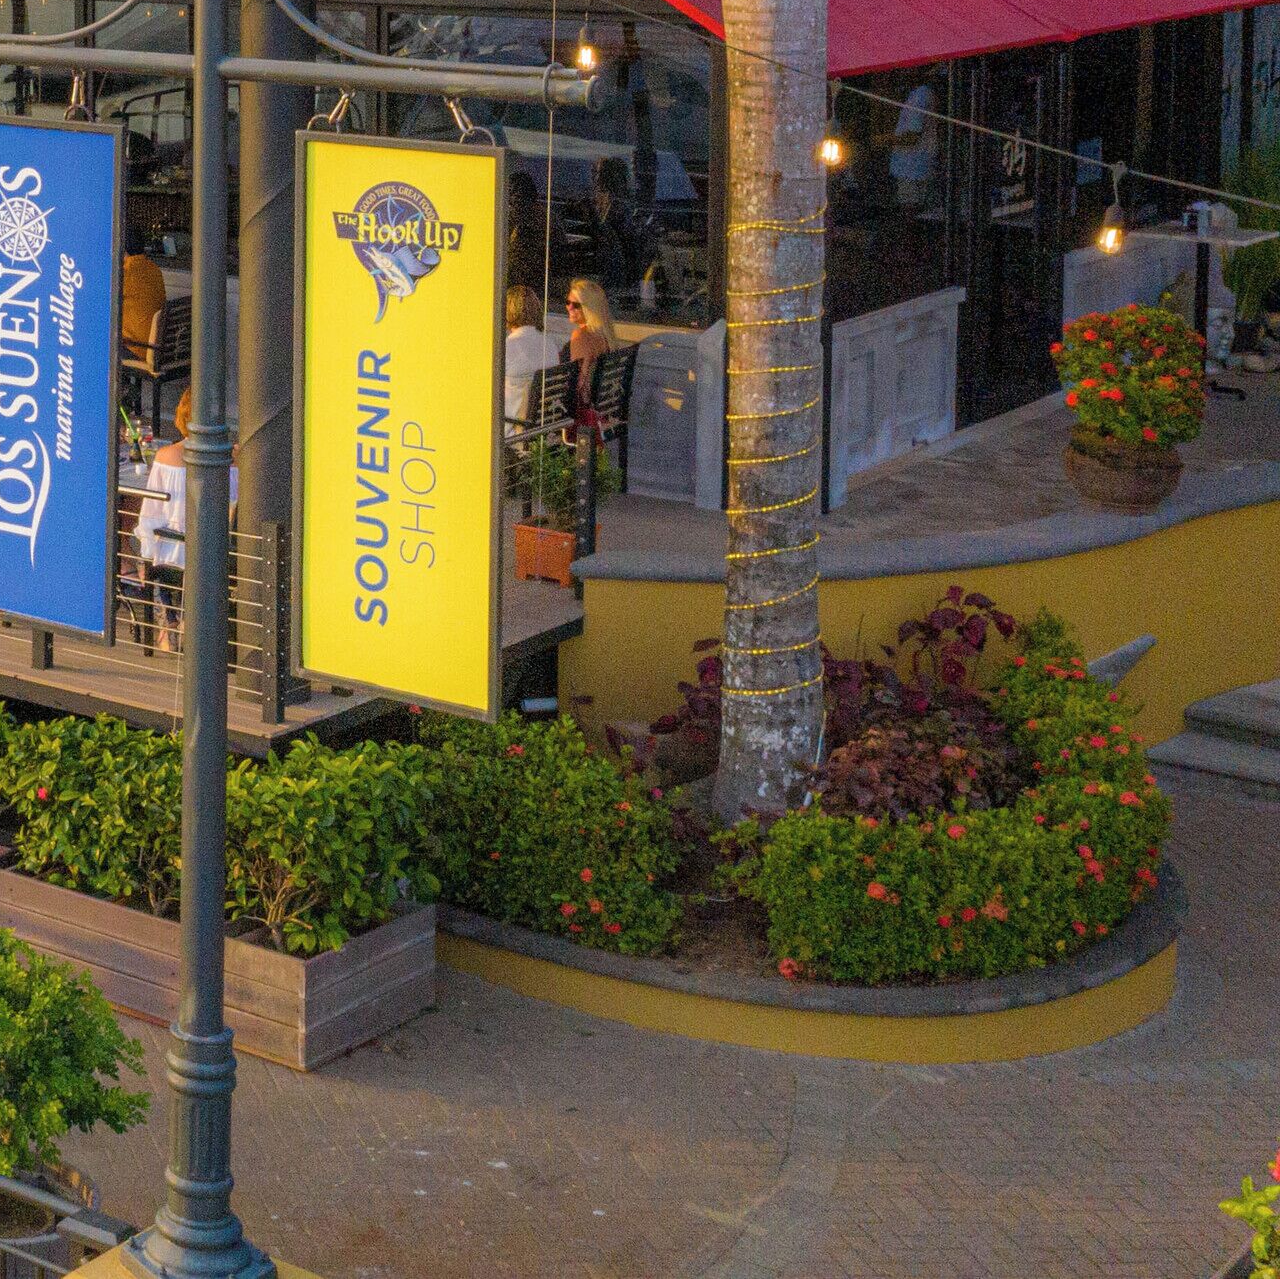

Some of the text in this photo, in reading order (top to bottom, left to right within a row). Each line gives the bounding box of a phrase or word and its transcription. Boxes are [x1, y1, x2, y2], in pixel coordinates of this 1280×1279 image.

[360, 192, 377, 213] GOOD
[399, 186, 421, 201] GREAT
[419, 198, 435, 221] FOOD
[49, 253, 83, 461] marina village
[354, 349, 391, 627] SOUVENIR
[399, 421, 437, 569] SHOP
